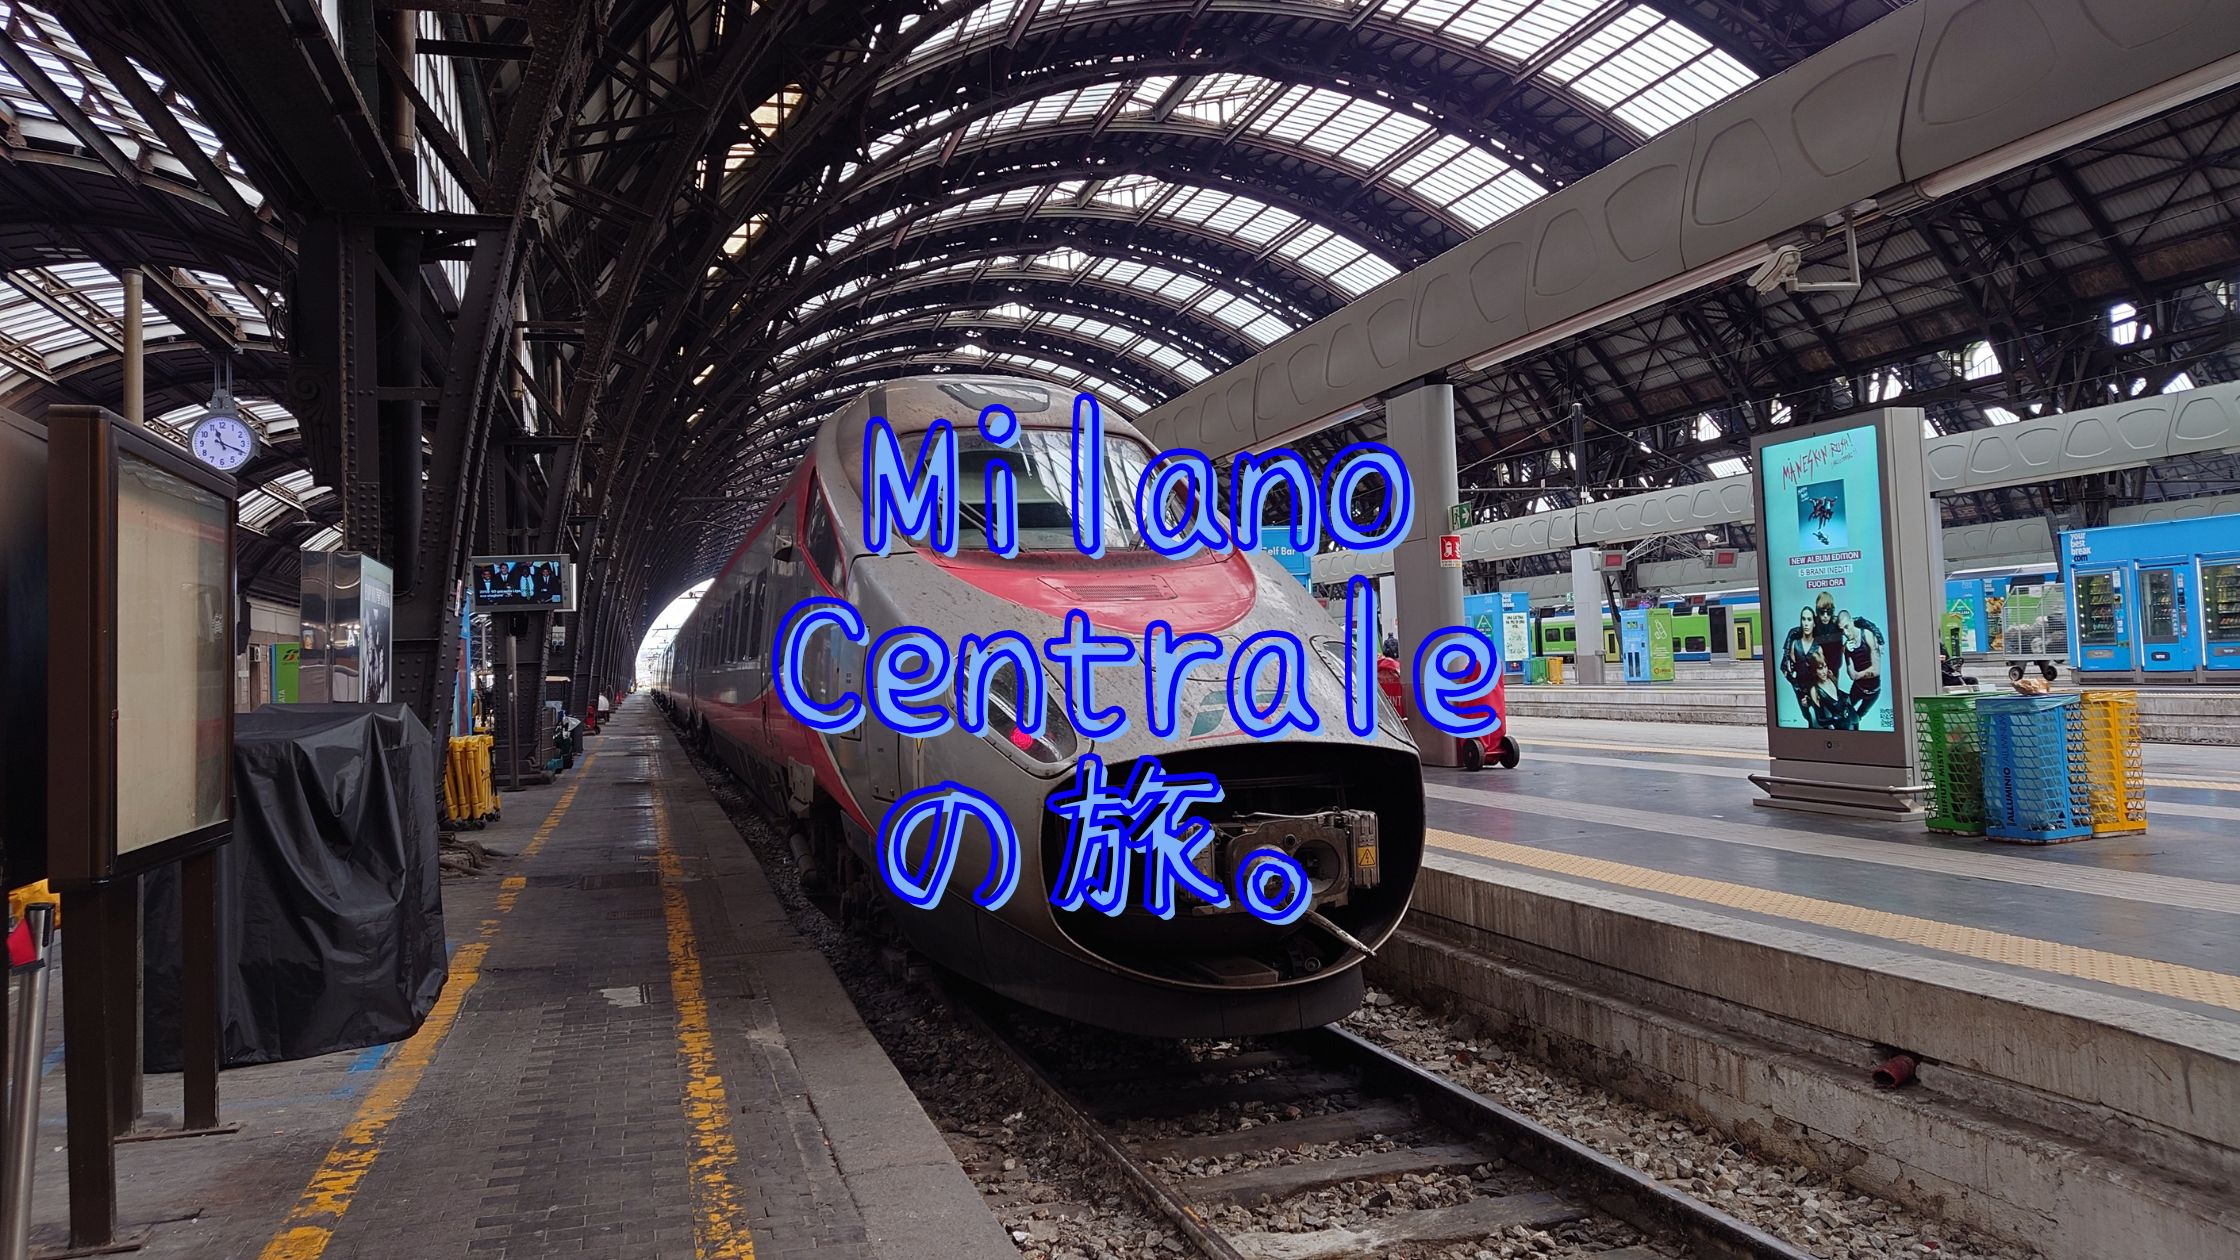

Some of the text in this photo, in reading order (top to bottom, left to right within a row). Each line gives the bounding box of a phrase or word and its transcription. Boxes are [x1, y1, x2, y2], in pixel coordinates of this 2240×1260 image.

[219, 421, 226, 429] 12
[1281, 546, 1296, 556] Bar
[1791, 551, 1859, 565] NEW ALBUM EDITION
[1806, 567, 1825, 576] BRANI
[1827, 565, 1851, 574] INEDITI
[1808, 578, 1844, 588] FUORI ORA
